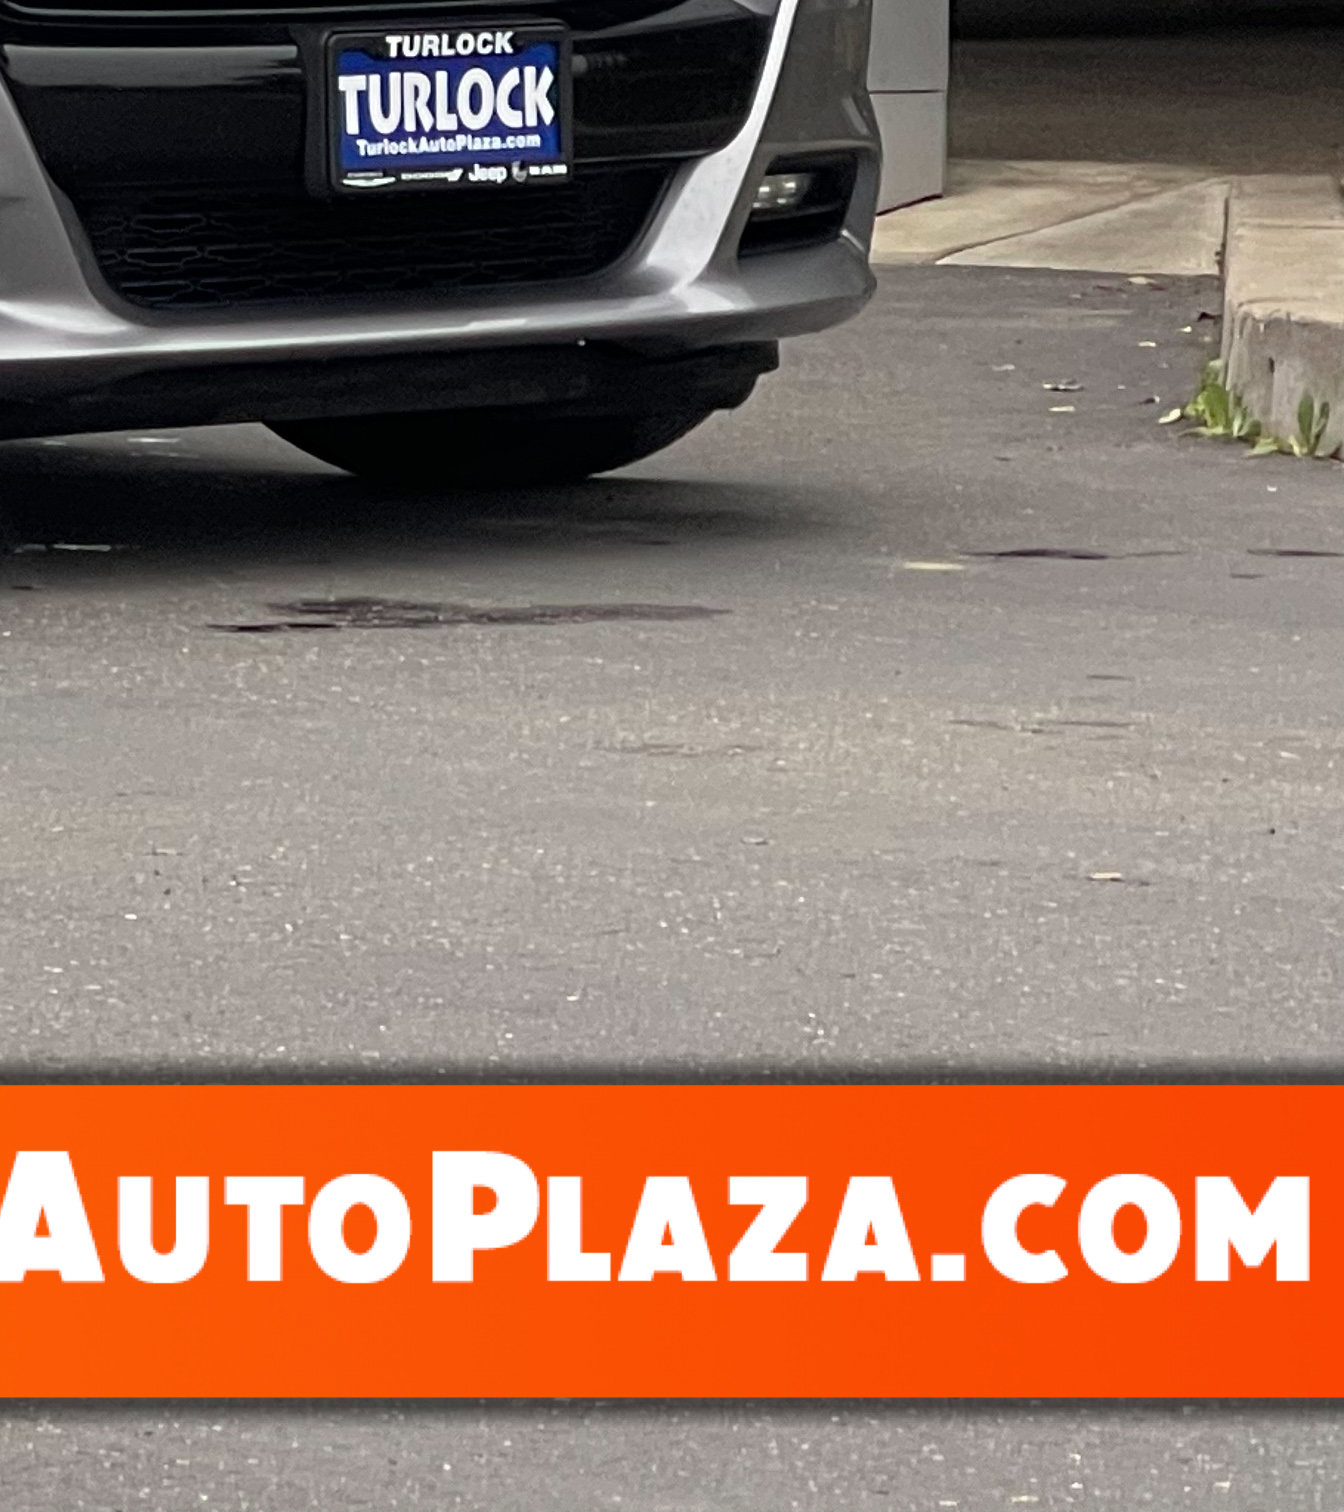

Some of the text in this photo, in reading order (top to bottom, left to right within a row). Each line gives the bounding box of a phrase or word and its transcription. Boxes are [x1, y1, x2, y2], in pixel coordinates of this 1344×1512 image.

[385, 31, 514, 58] TURLOCK
[338, 65, 555, 136] TURLOCK
[356, 133, 541, 157] TurlockAutoPlaza.com
[468, 163, 508, 184] Jeep
